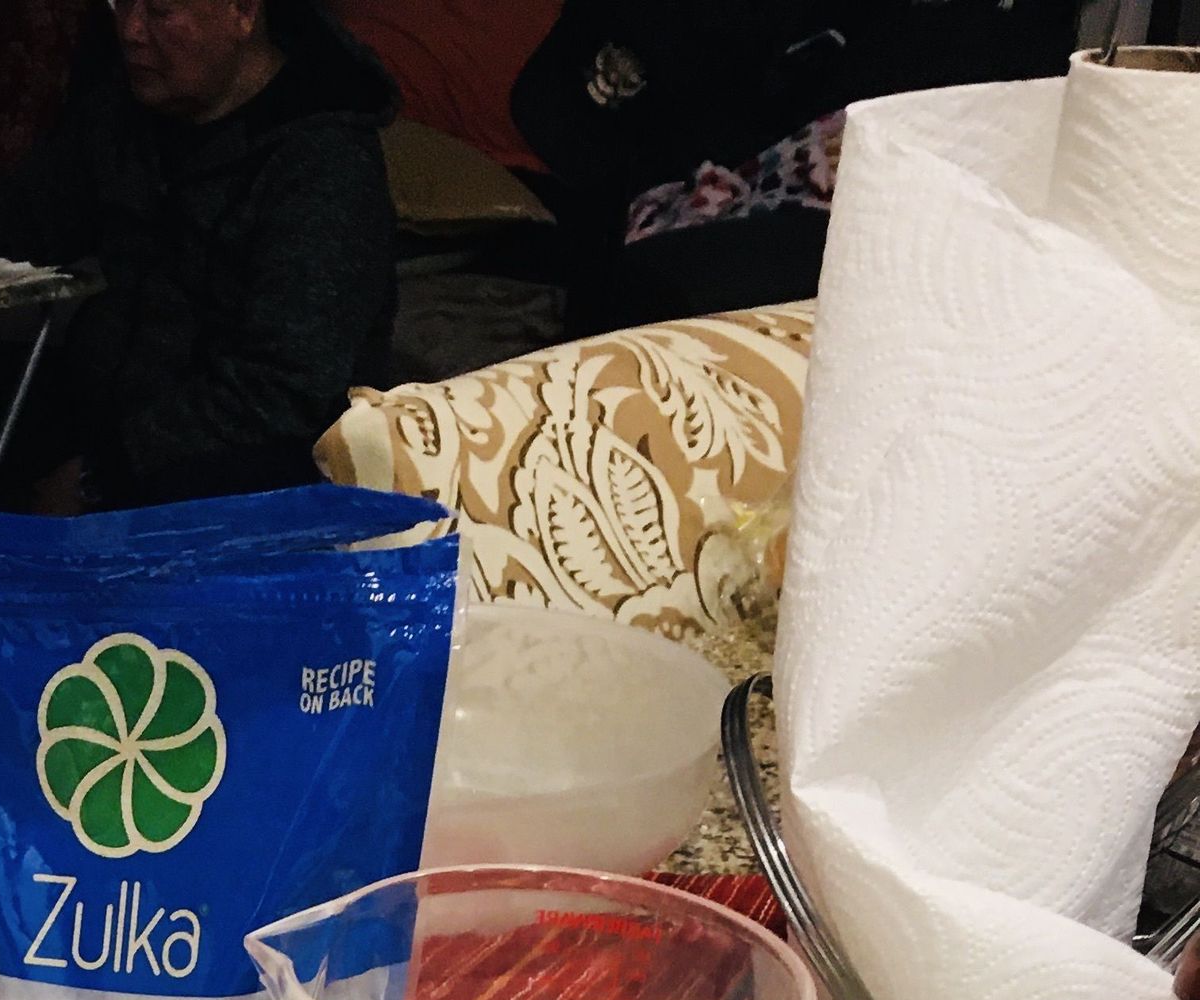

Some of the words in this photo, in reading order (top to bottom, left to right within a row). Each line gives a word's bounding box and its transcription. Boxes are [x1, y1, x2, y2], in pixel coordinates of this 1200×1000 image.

[302, 659, 376, 693] RECIPE
[300, 692, 324, 714] ON
[329, 683, 374, 710] BACK
[23, 873, 200, 978] Zulka
